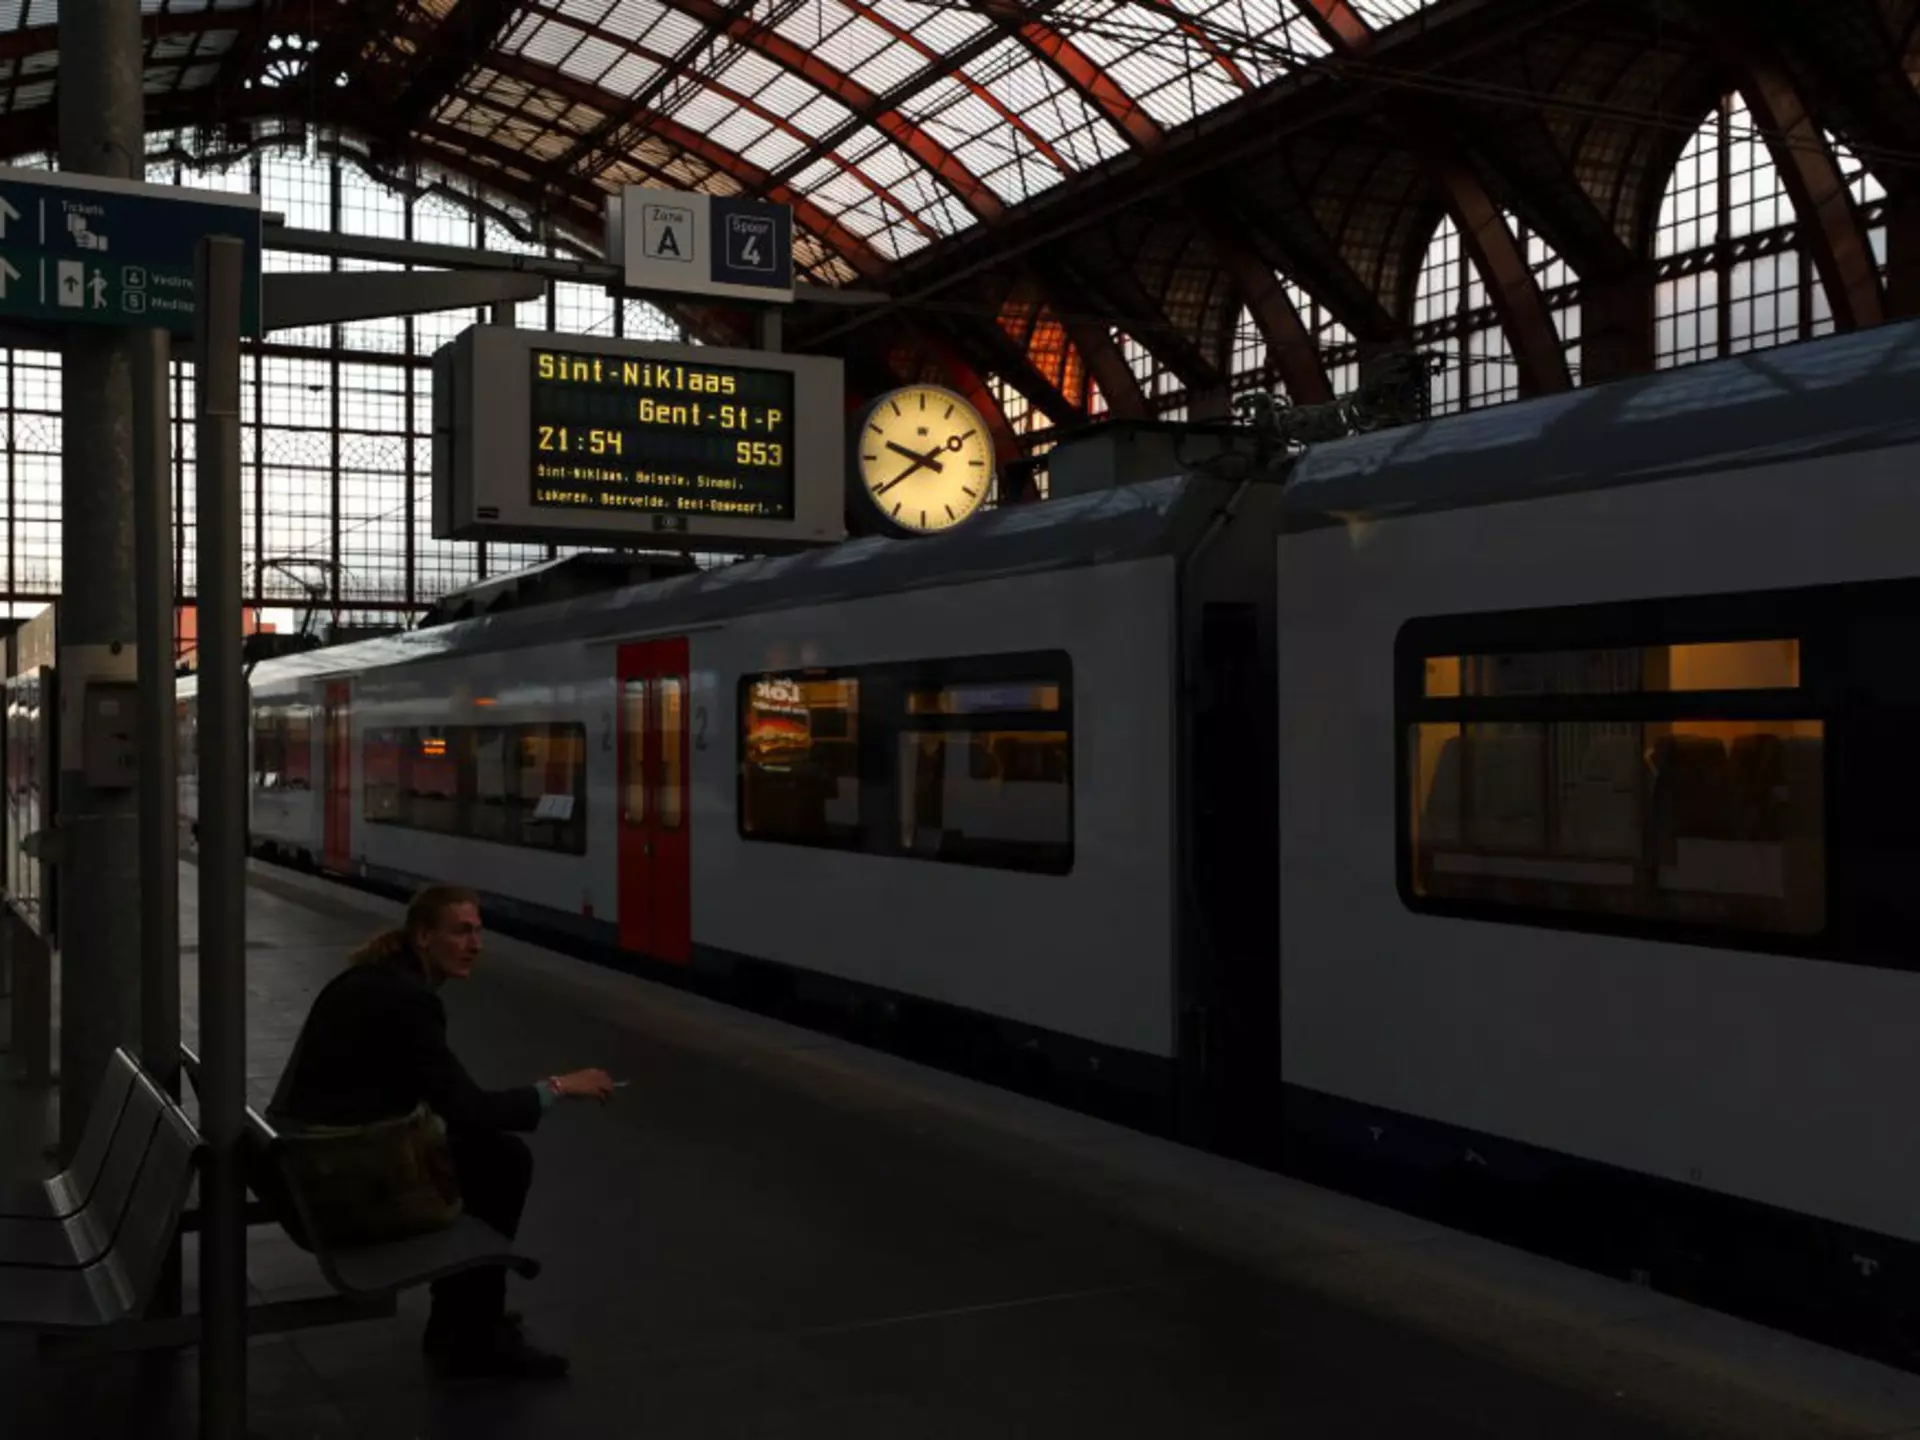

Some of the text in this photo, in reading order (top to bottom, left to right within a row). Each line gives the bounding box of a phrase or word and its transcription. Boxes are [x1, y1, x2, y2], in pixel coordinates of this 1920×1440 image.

[652, 208, 684, 223] Zone
[732, 217, 769, 234] Spoor
[657, 225, 681, 256] A
[741, 235, 761, 265] 4
[538, 353, 736, 395] Sint-Niklaas
[639, 398, 783, 432] Gent-St-P
[538, 426, 783, 466] 21:54 S53
[696, 706, 708, 752] 2
